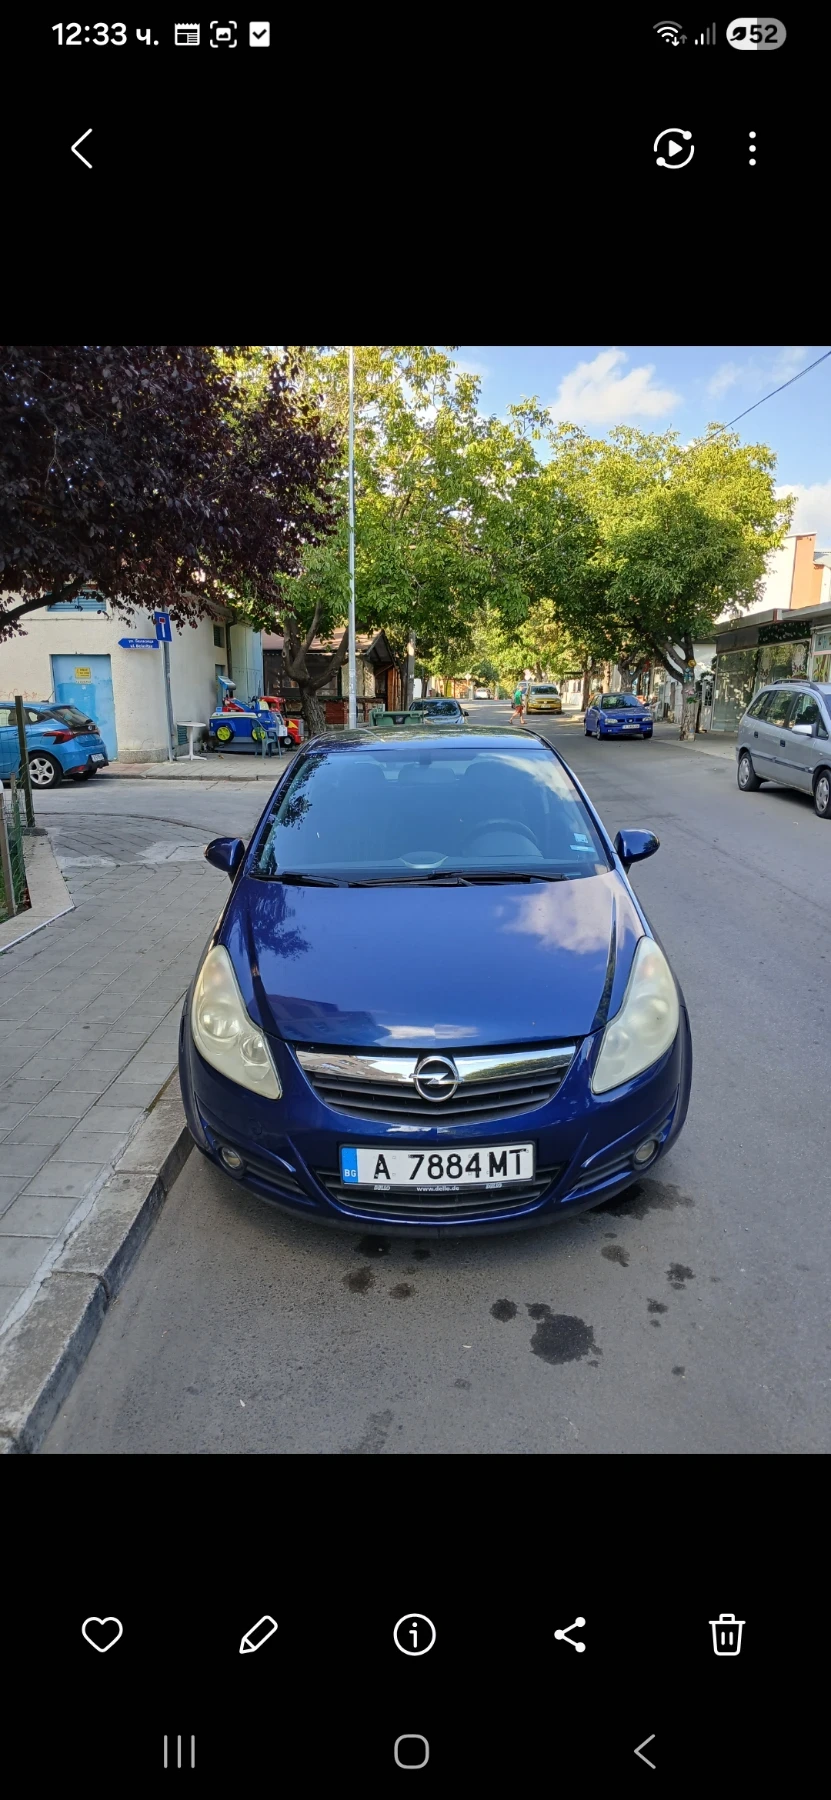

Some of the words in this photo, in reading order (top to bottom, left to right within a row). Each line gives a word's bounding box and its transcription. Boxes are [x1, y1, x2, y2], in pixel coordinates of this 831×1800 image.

[345, 1169, 357, 1177] BG
[373, 1154, 391, 1180] A
[408, 1152, 482, 1180] 7884
